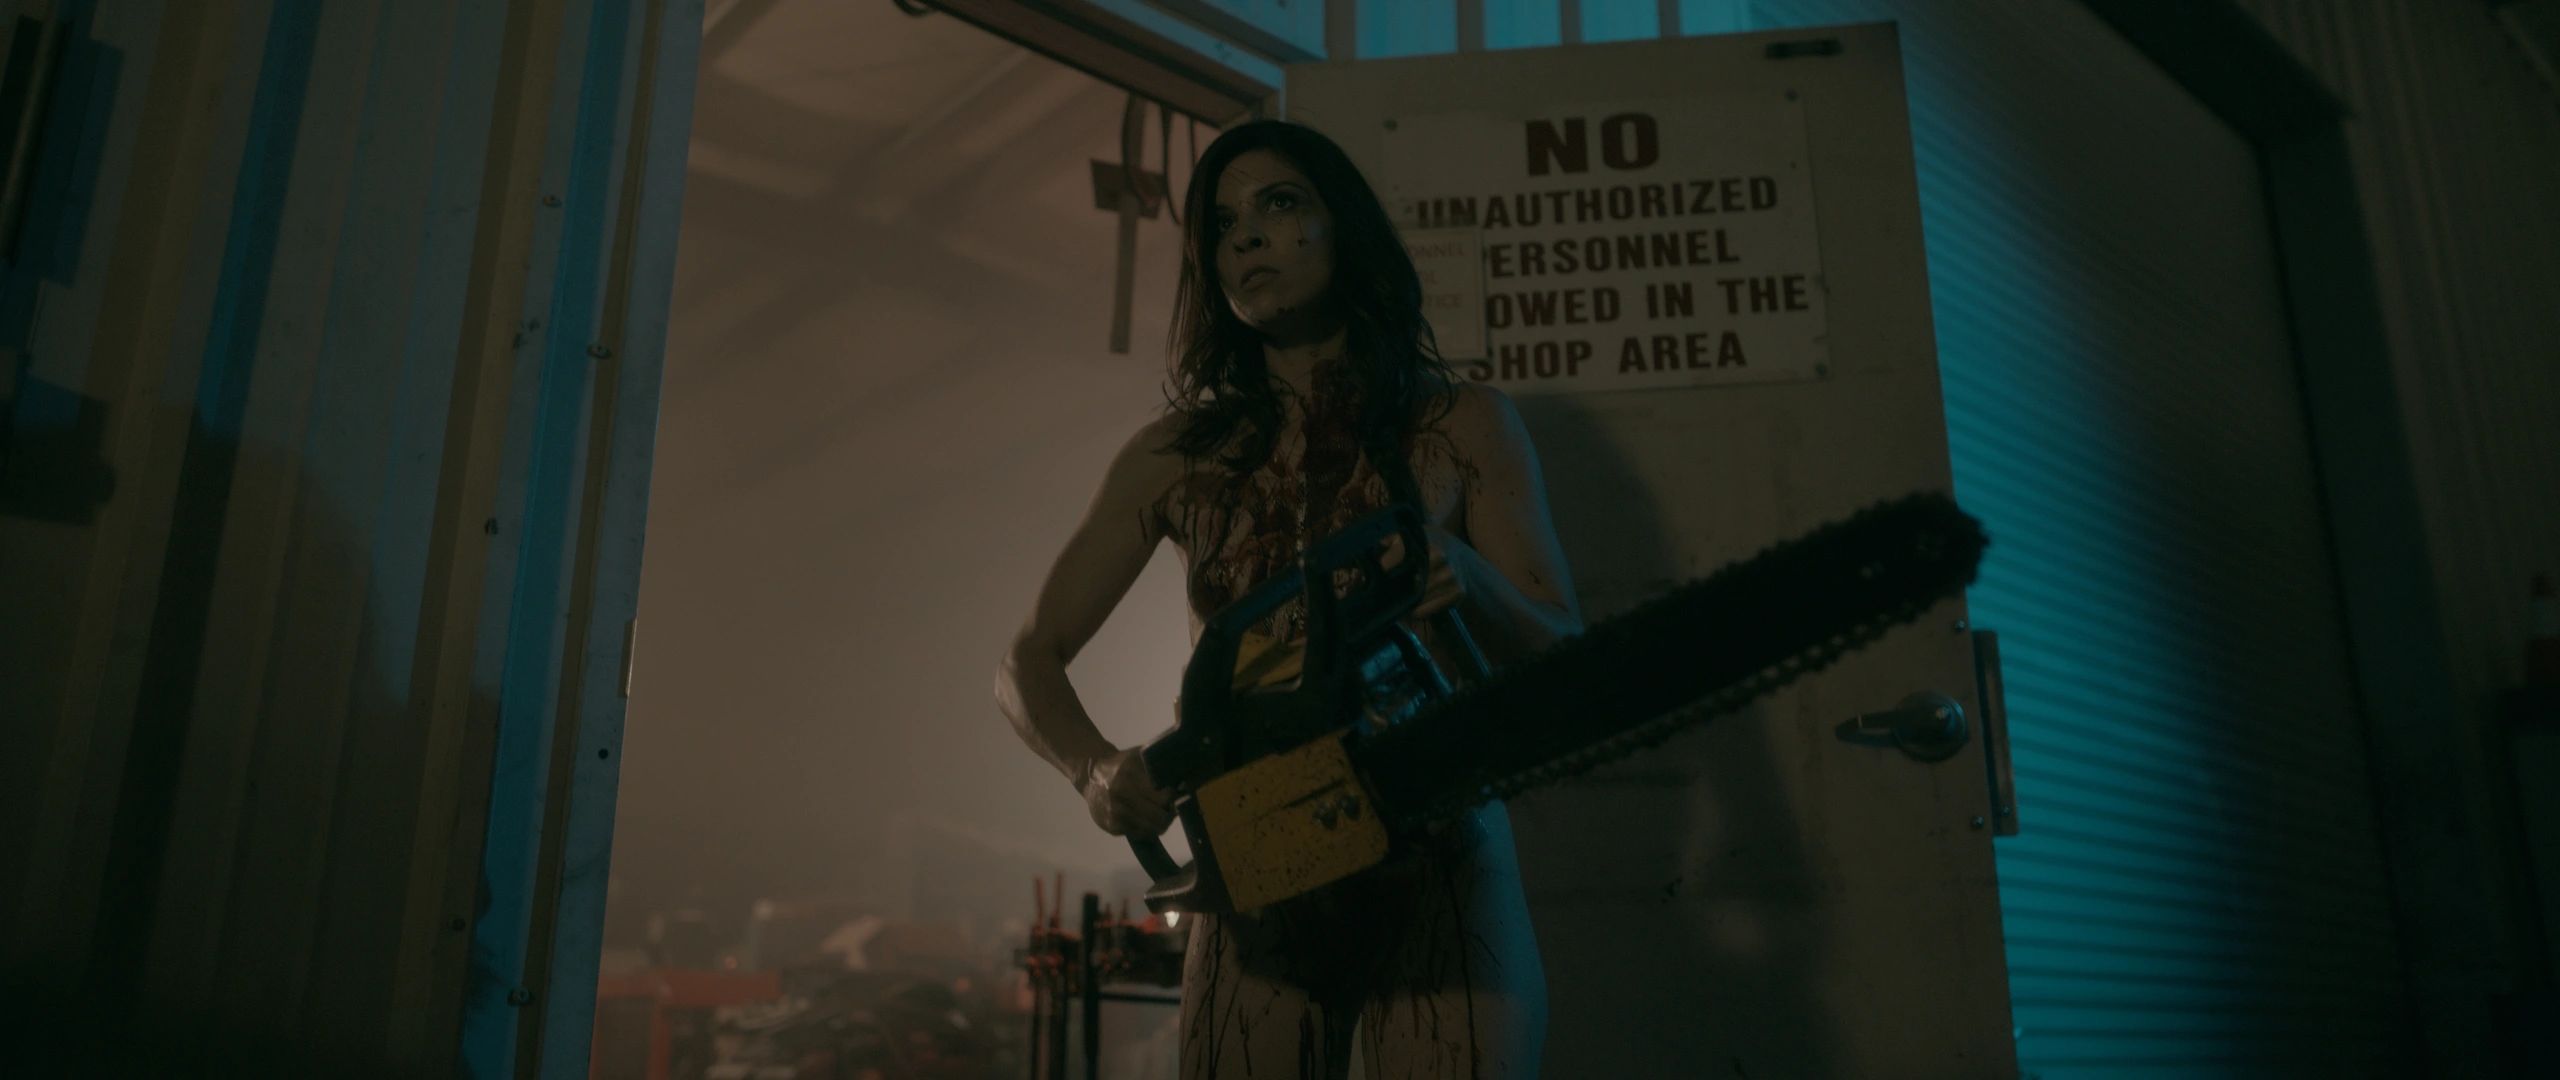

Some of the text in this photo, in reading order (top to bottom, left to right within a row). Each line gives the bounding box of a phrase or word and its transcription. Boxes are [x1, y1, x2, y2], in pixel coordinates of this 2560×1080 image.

[1525, 112, 1660, 177] NO
[1417, 175, 1779, 229] UNAUTHORIZED
[1482, 228, 1741, 279] ERSONNEL
[1484, 273, 1810, 329] OWED IN THE
[1618, 329, 1748, 375] AREA
